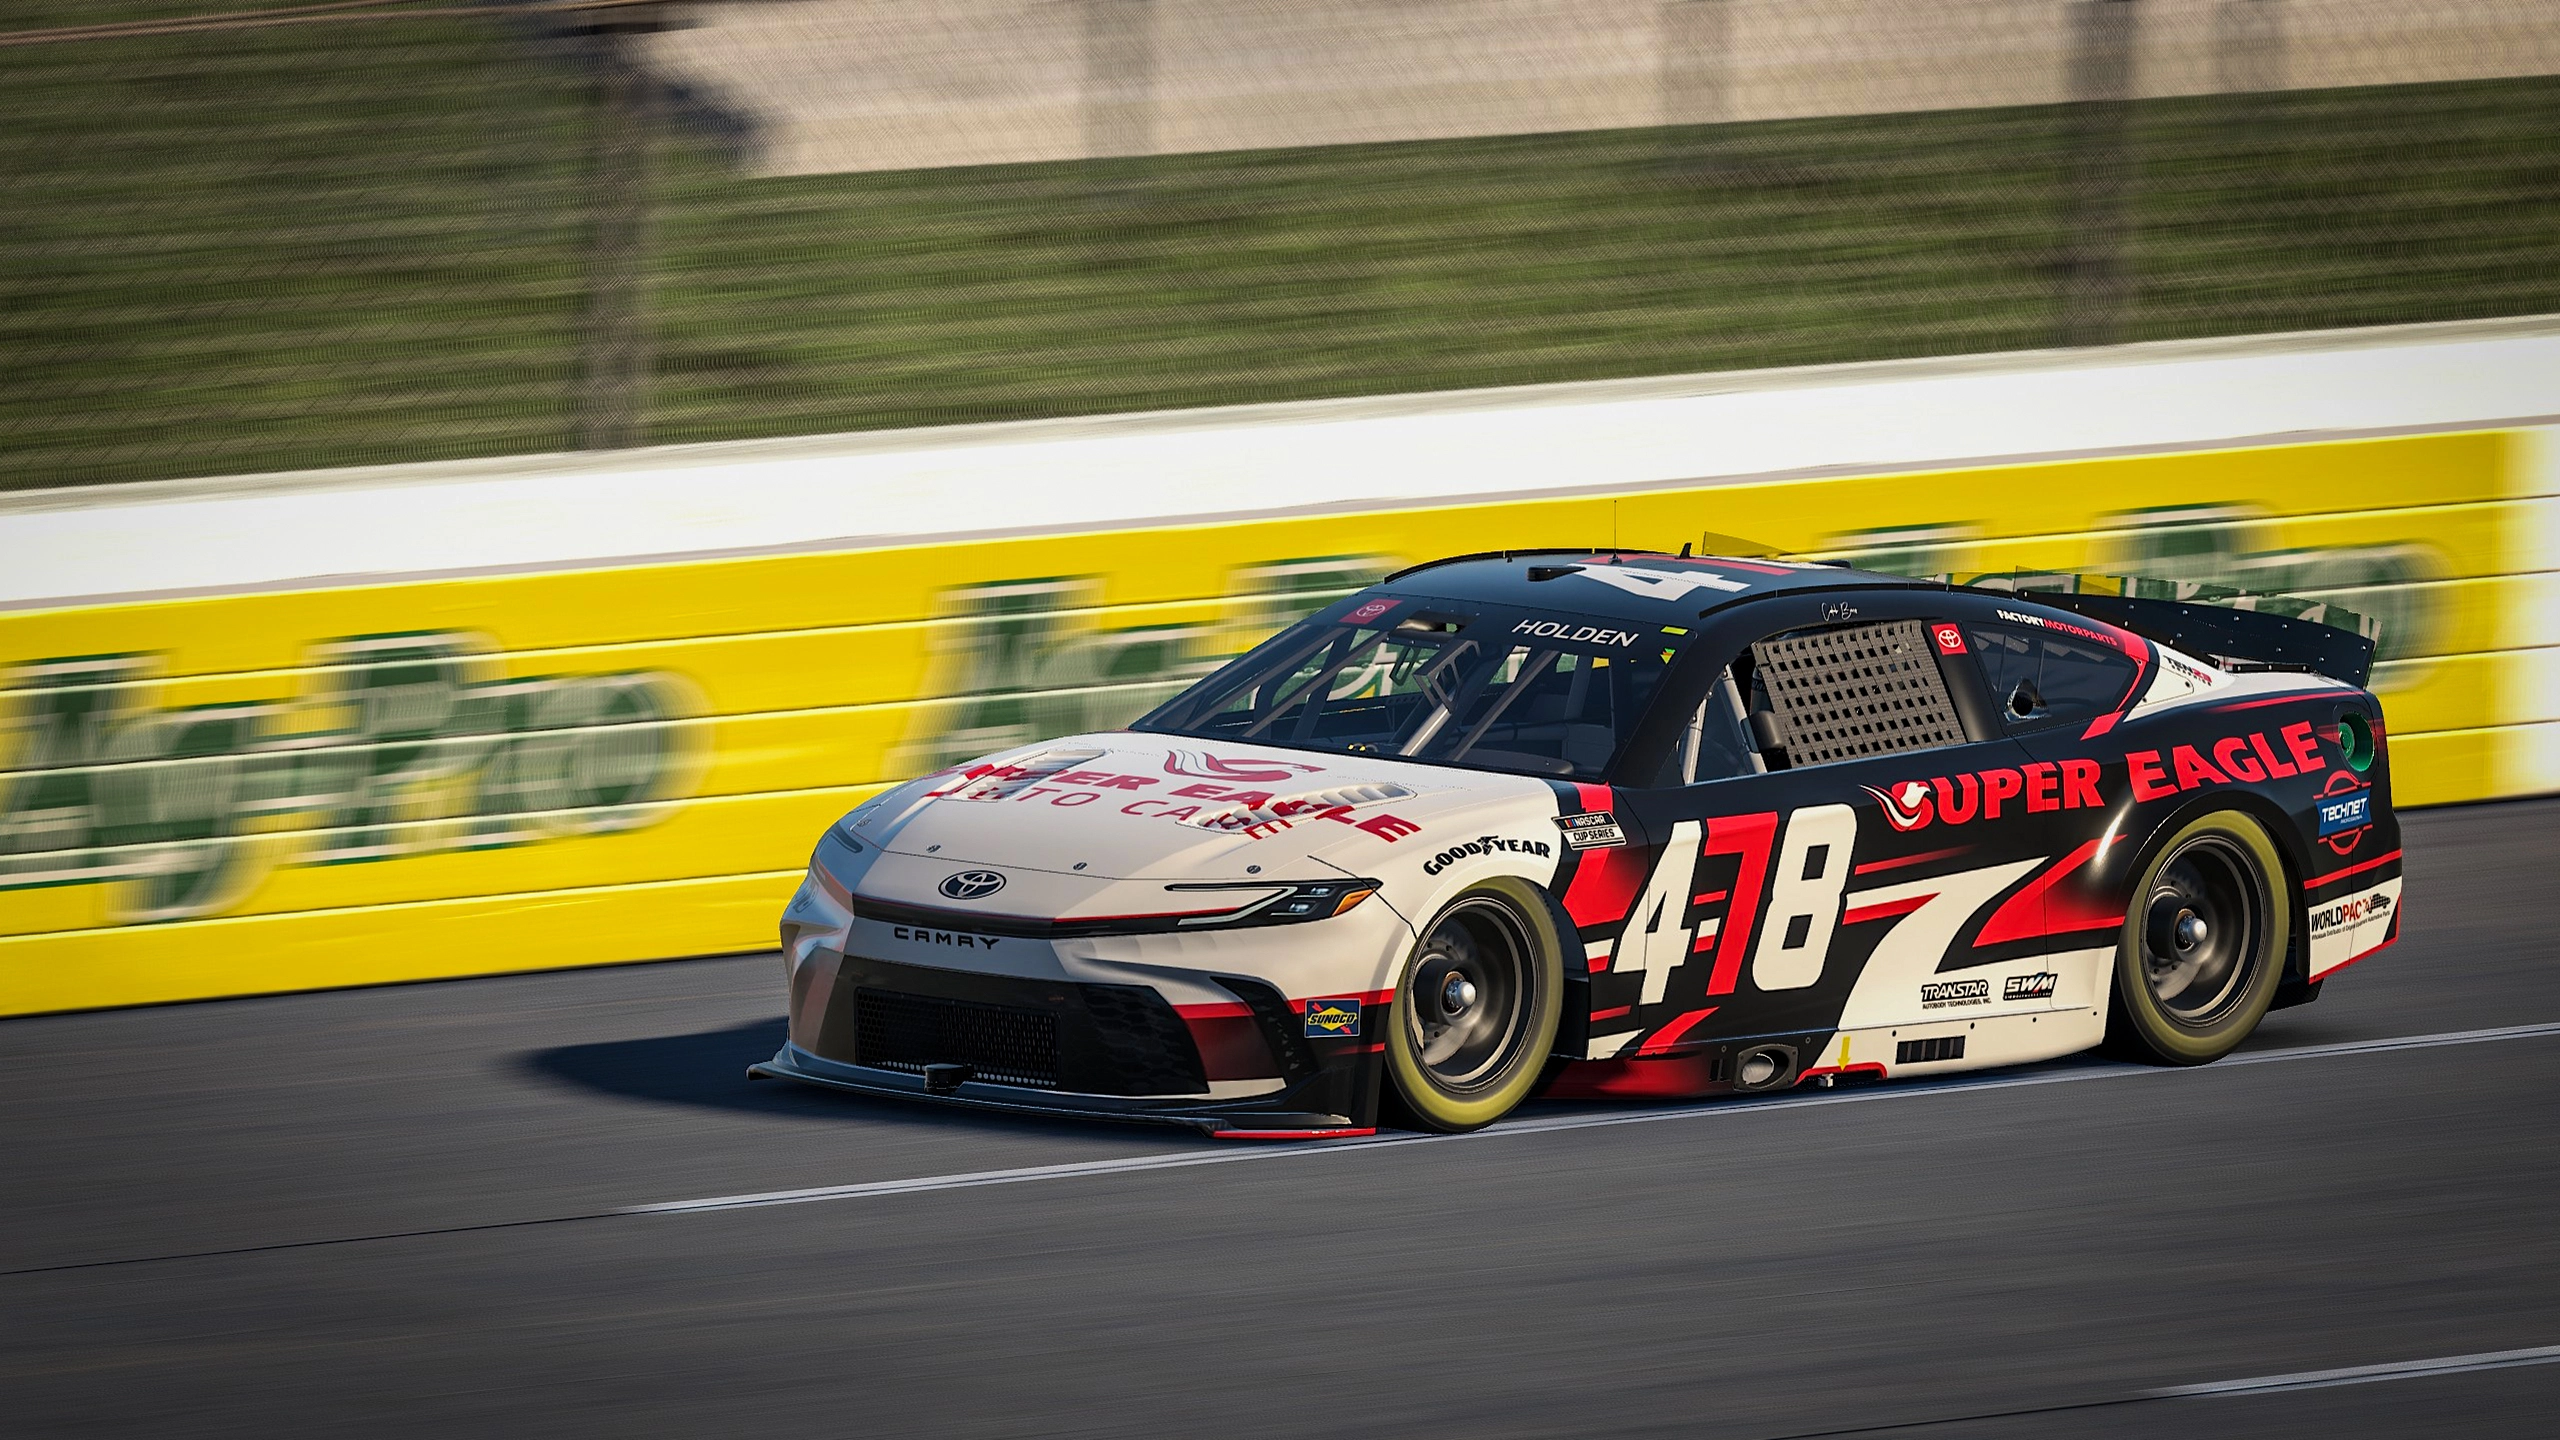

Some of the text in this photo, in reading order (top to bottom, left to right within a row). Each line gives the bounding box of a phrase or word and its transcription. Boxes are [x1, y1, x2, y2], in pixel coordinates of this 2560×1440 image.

[1511, 619, 1640, 648] HOLDEN
[1889, 720, 2327, 831] SUPER EAGLE
[1574, 815, 1606, 828] NASCAR
[1573, 829, 1615, 842] CUP SERIES
[1423, 835, 1550, 876] GOODYEAR
[2311, 900, 2362, 932] WORLDPAC
[894, 926, 1000, 950] CAMRY
[1921, 980, 1988, 1001] TRANSTAR
[2005, 973, 2056, 994] SWM
[1309, 1013, 1356, 1025] SUNOCO
